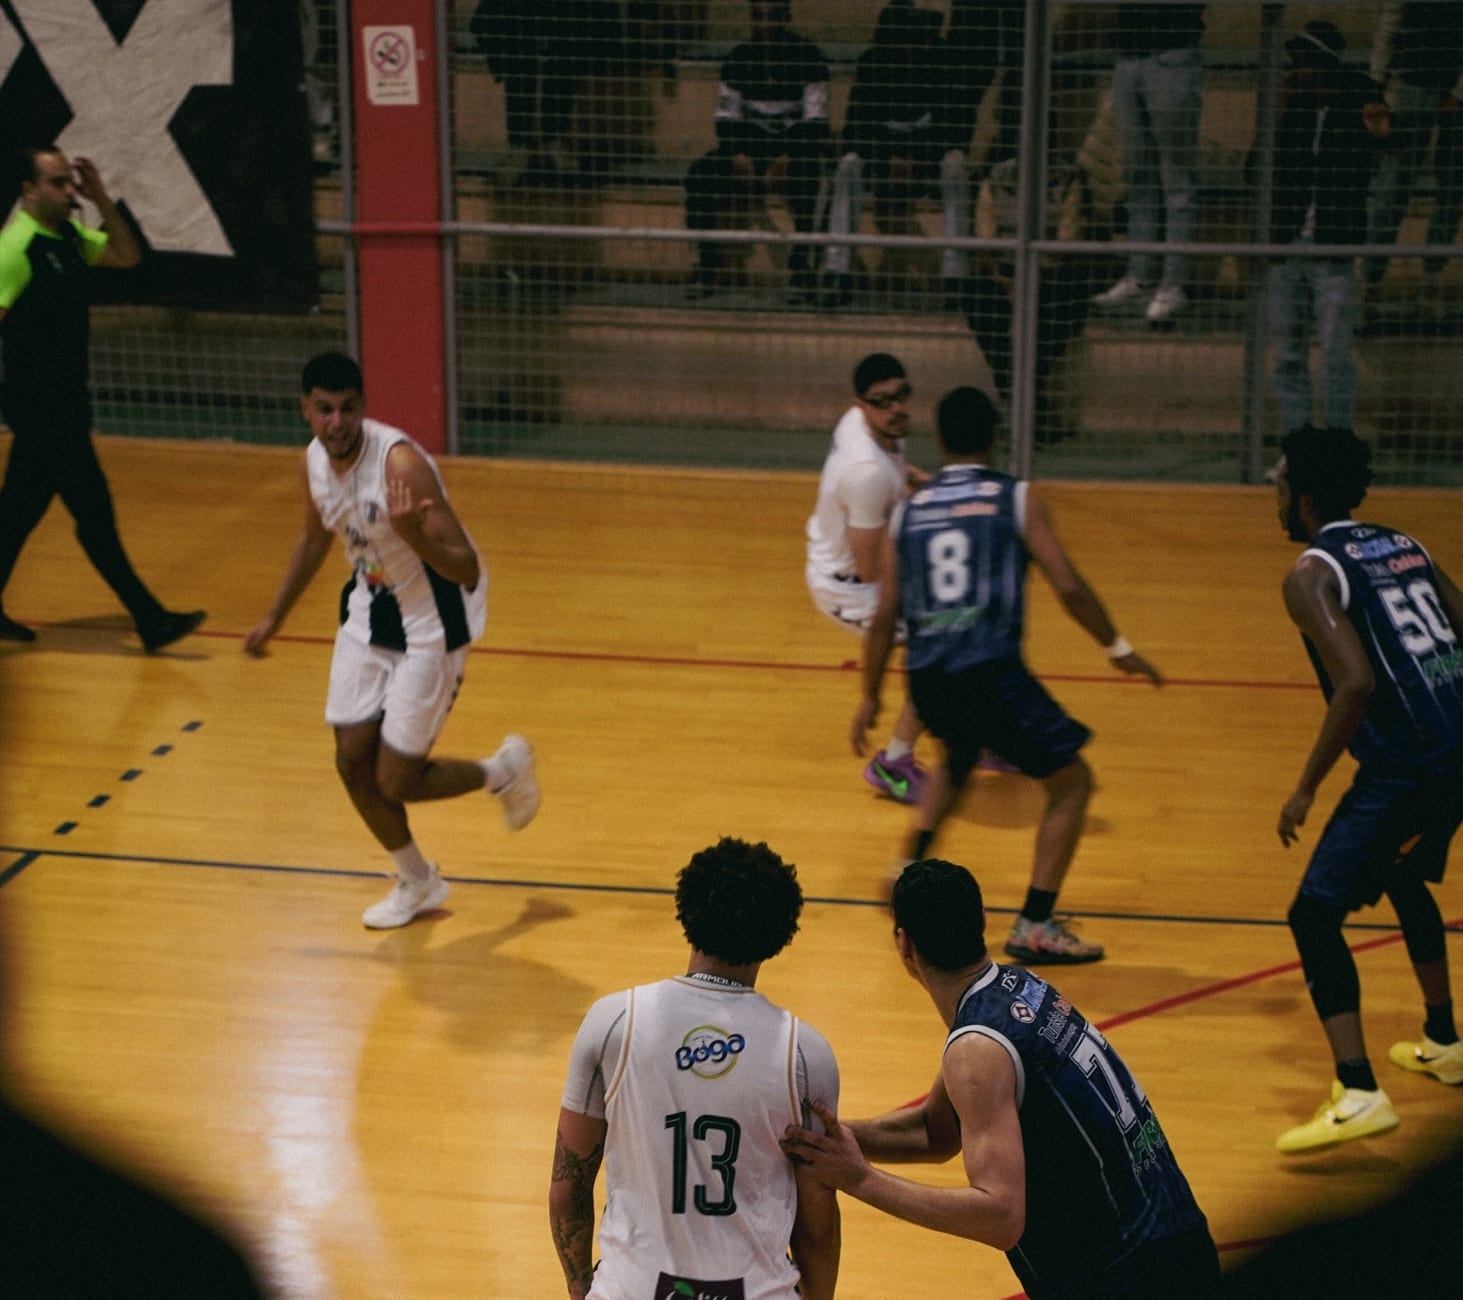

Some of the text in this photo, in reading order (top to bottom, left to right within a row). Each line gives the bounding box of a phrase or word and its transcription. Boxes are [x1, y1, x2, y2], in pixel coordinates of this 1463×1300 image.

[0, 0, 236, 258] X
[928, 529, 971, 604] 8
[1377, 578, 1457, 656] 50
[675, 1033, 746, 1071] Boga
[664, 1111, 741, 1216] 13
